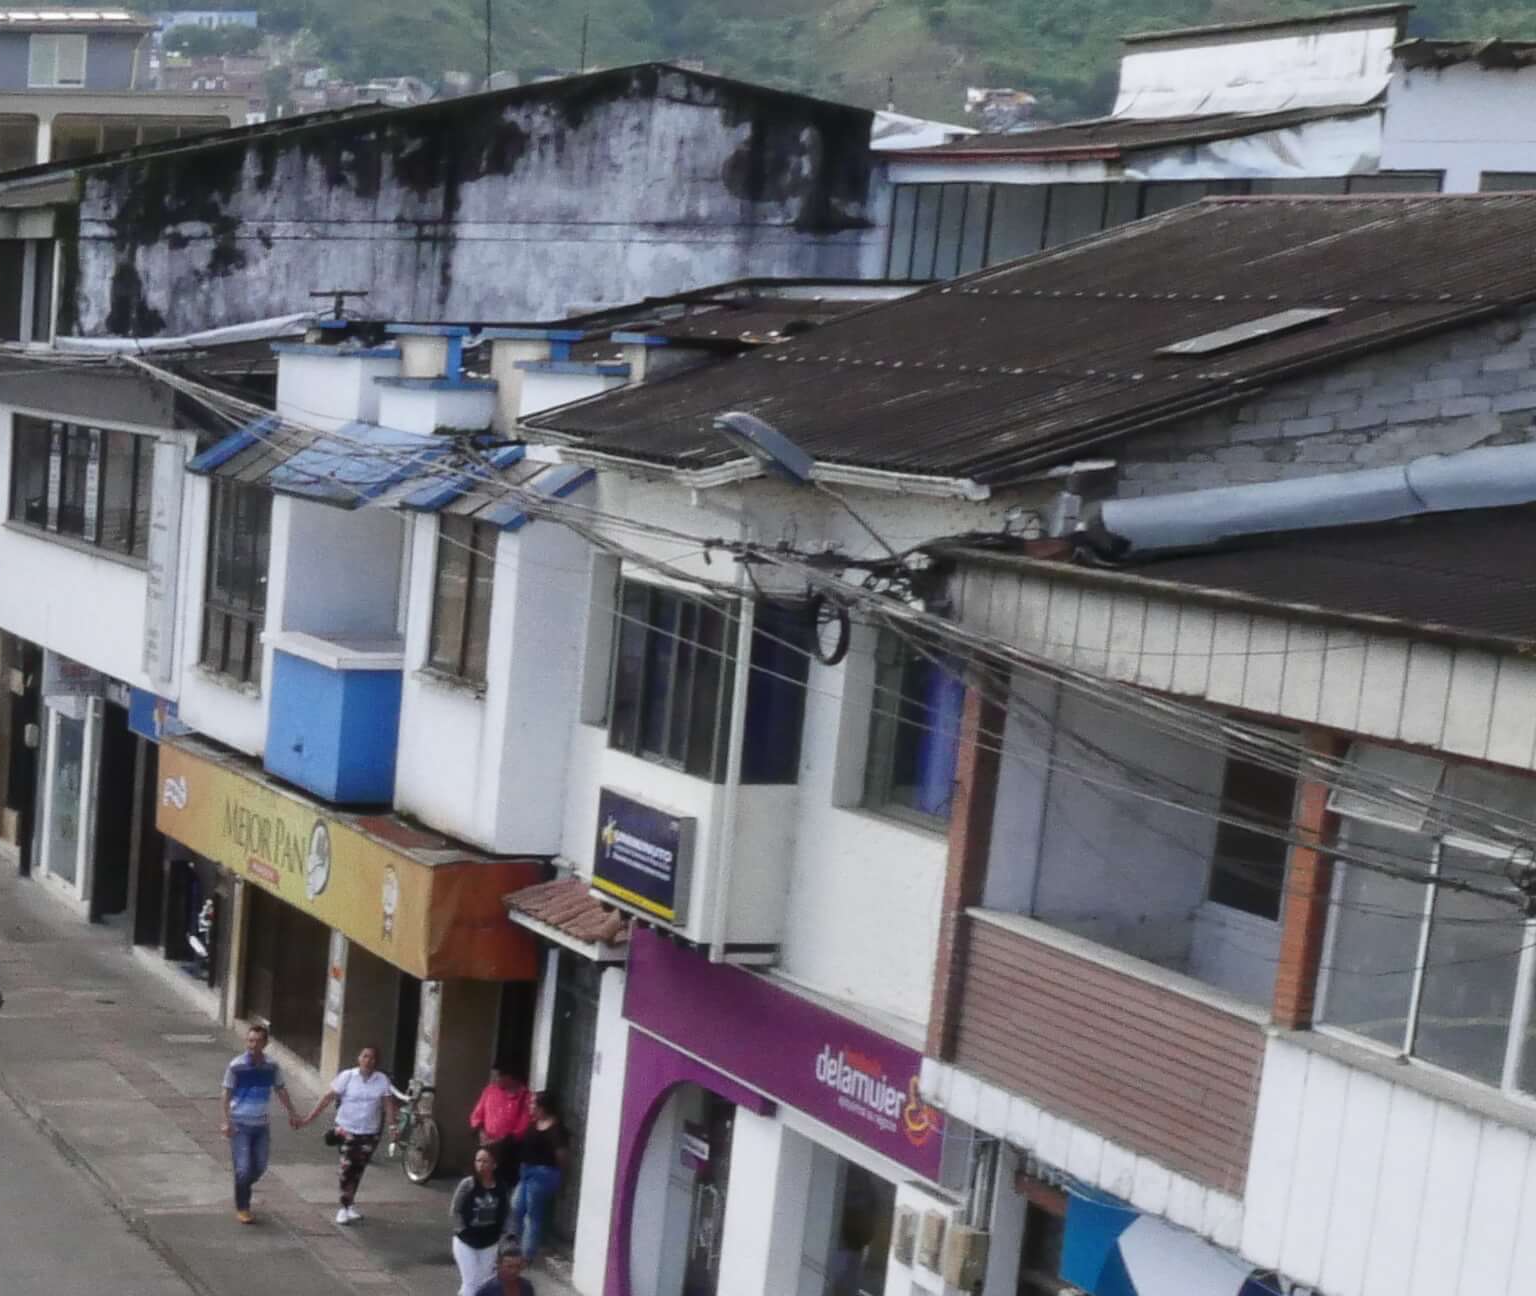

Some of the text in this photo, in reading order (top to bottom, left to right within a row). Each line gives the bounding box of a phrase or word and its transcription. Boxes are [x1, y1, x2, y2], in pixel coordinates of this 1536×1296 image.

[223, 800, 272, 860] MEJOR
[274, 815, 306, 876] PAN
[815, 1043, 907, 1120] delamujer
